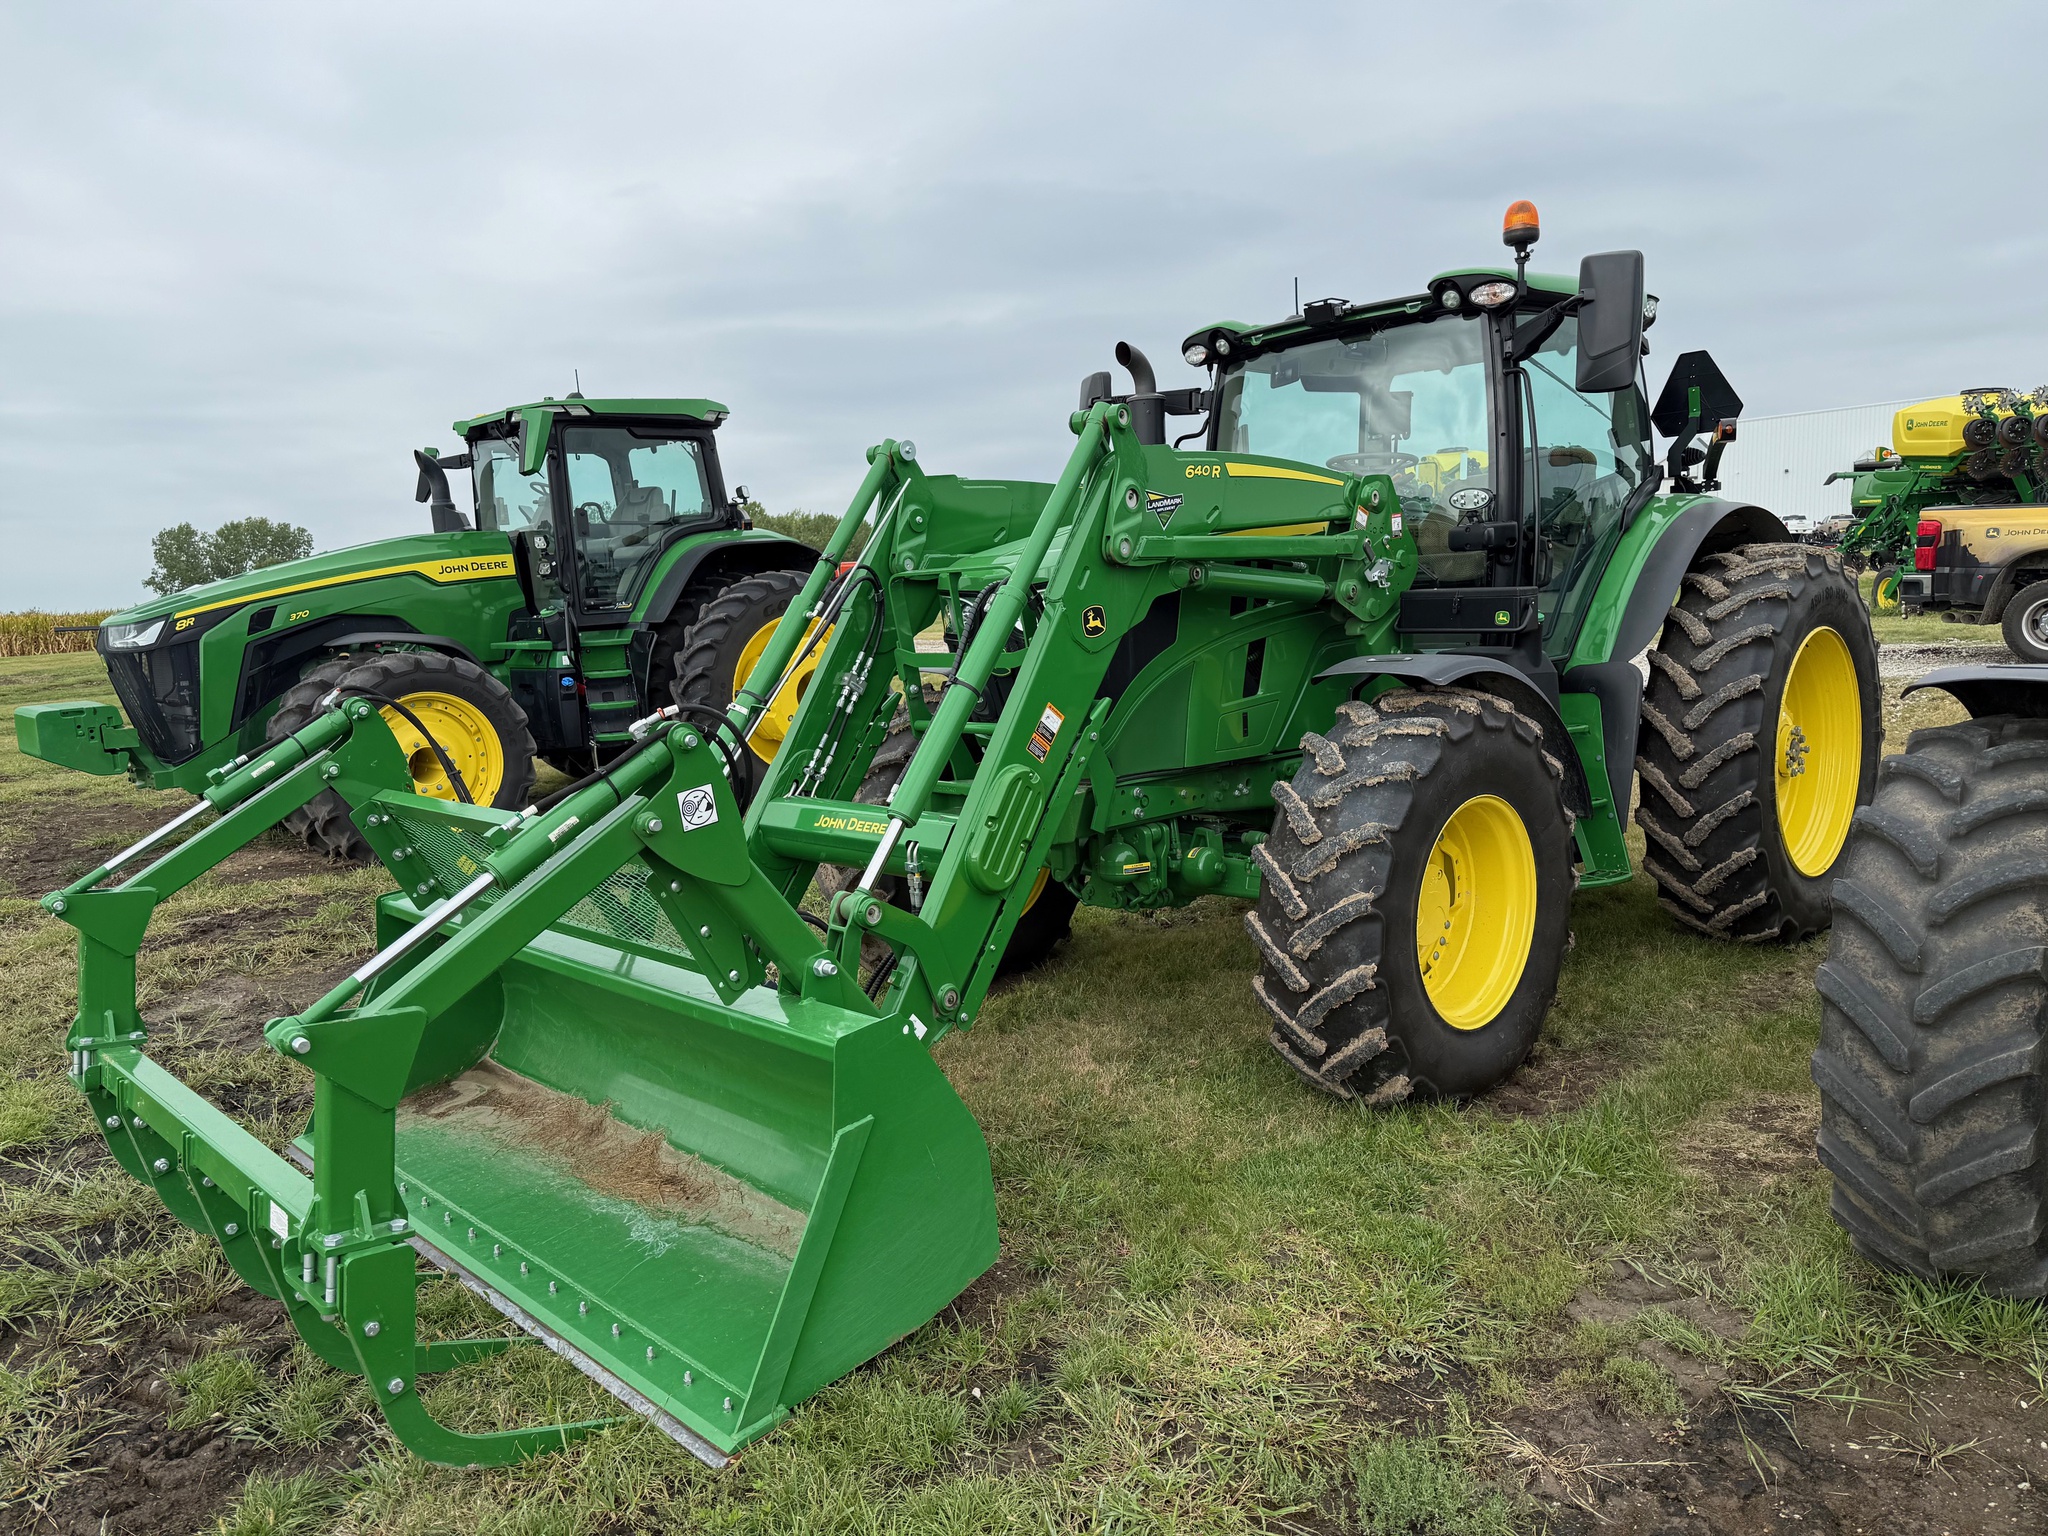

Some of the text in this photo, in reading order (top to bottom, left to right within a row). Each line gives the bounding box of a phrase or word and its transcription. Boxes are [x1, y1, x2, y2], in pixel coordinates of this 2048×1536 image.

[439, 561, 508, 575] JOHN DEERE
[289, 610, 310, 621] 370
[175, 617, 195, 631] 8R
[814, 815, 888, 834] JOHN DEERE
